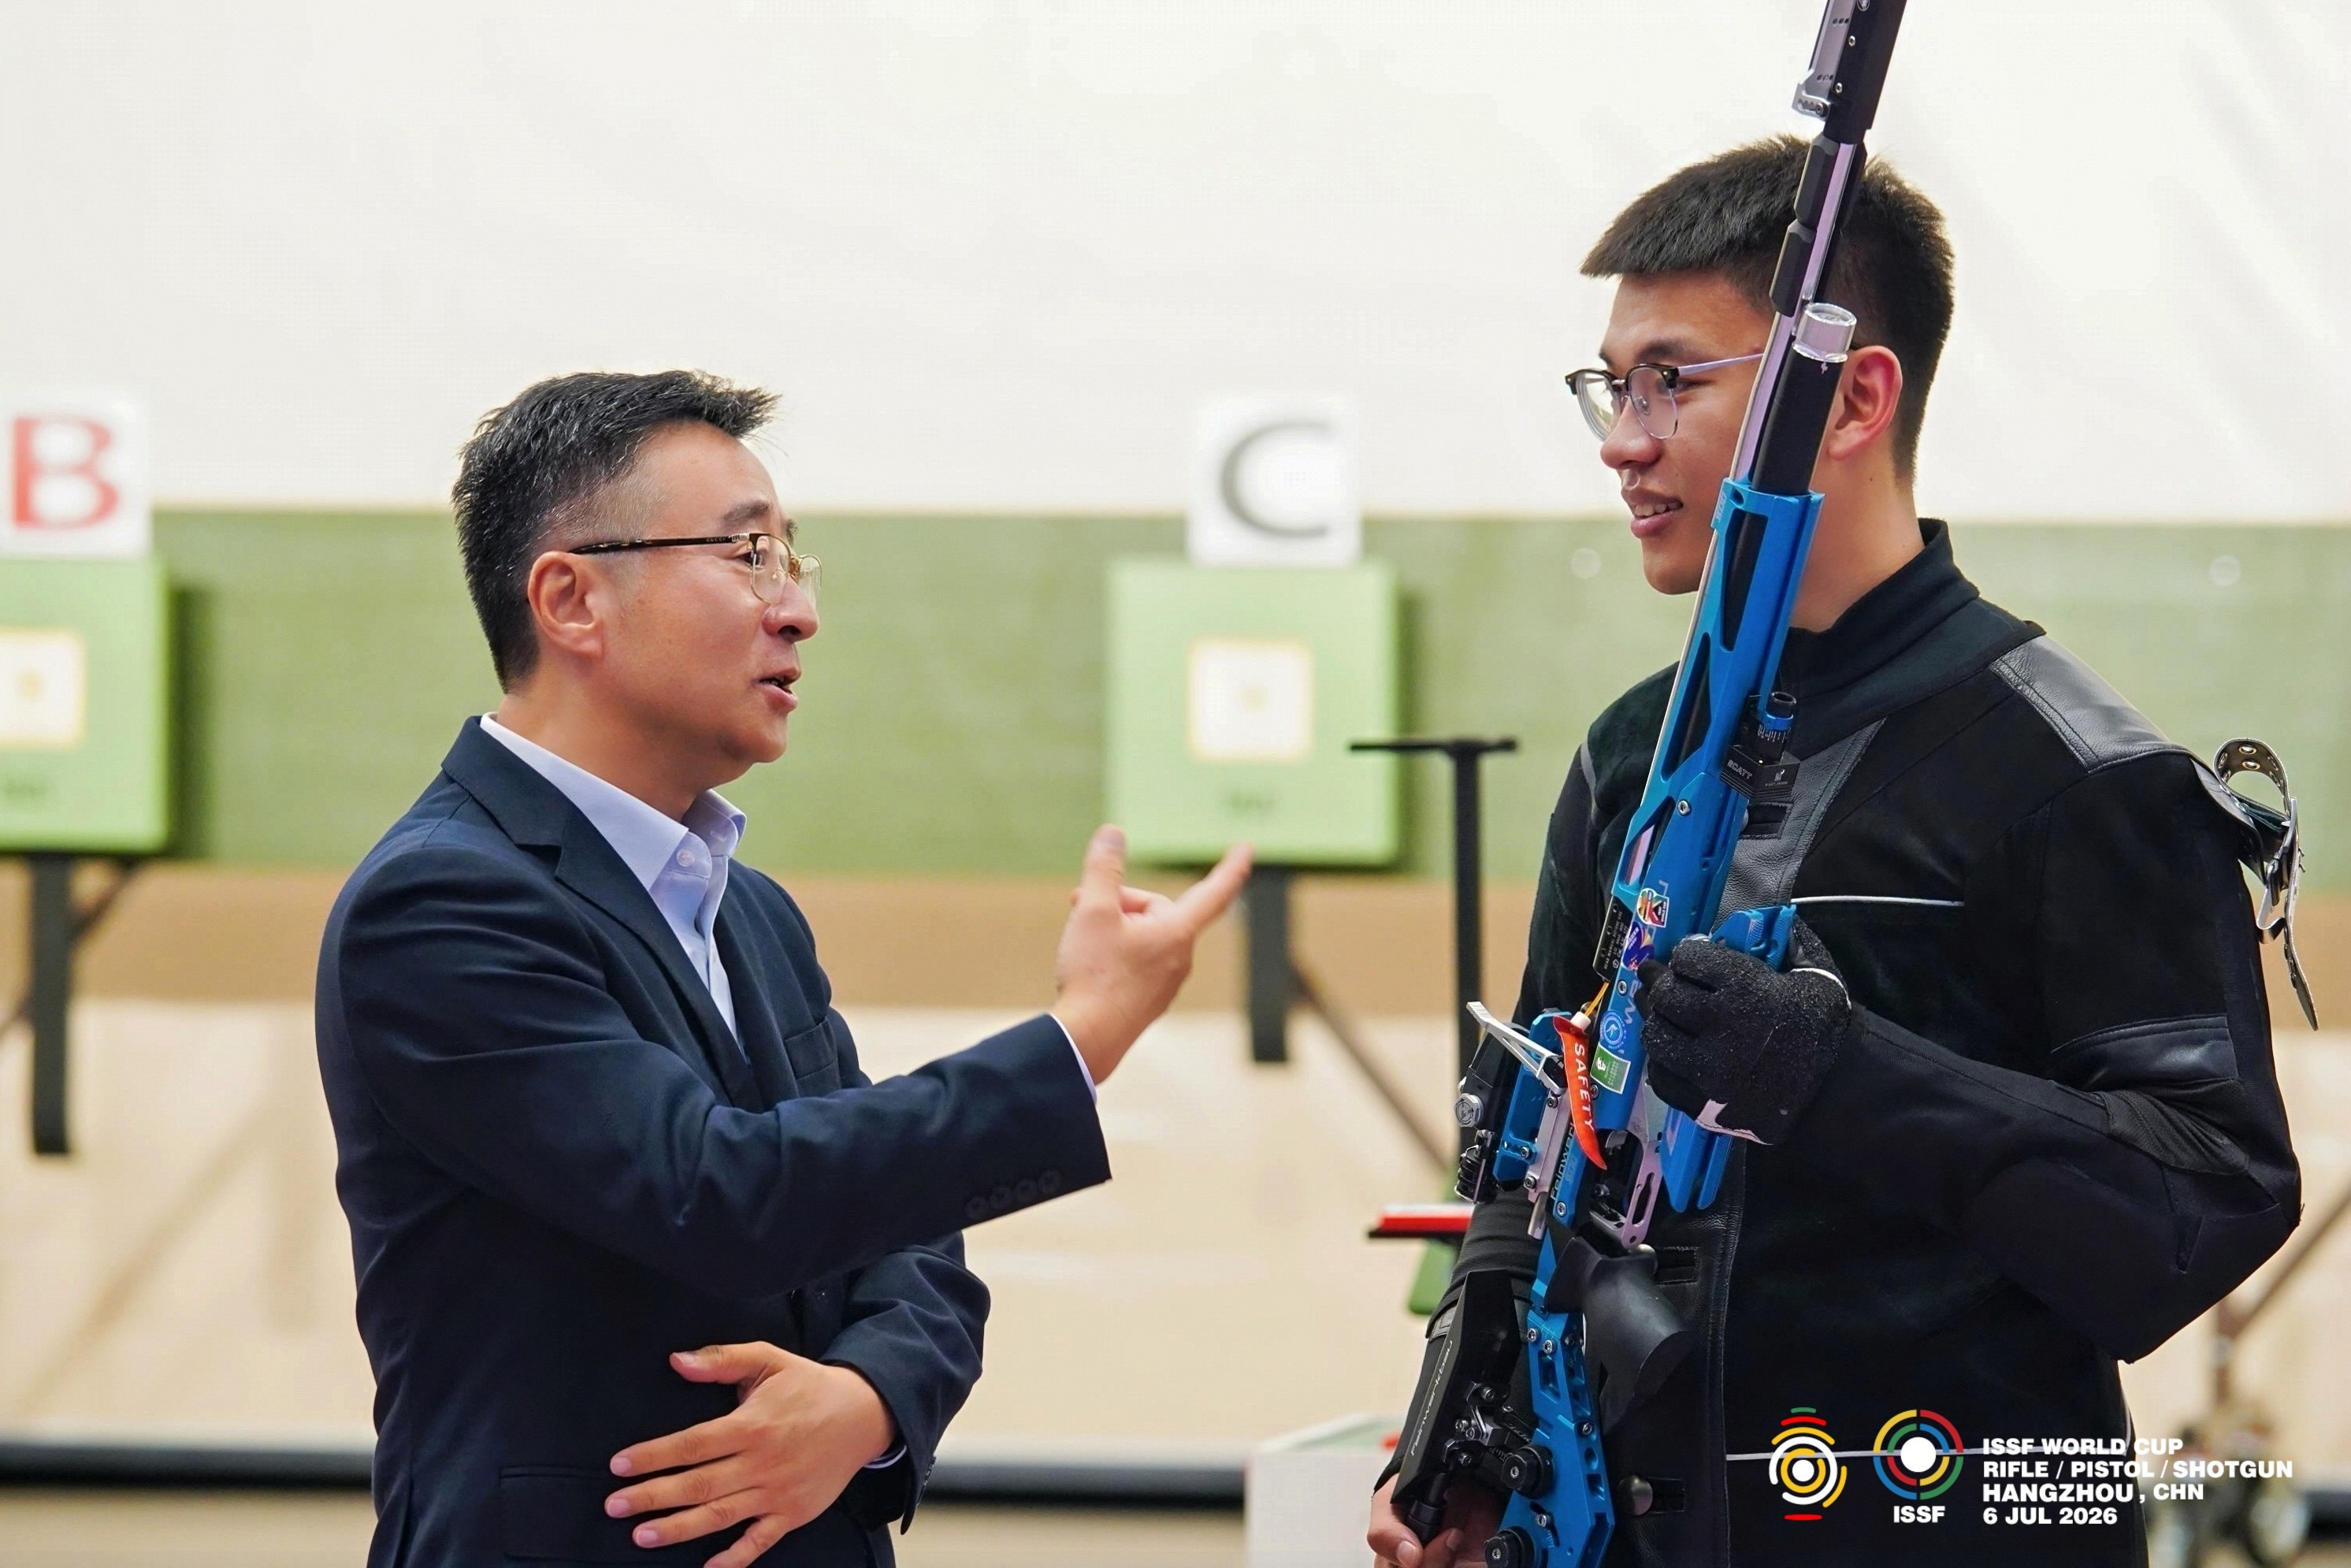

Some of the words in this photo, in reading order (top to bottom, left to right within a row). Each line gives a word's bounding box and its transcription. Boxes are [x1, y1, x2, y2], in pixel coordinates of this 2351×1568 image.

[10, 414, 122, 530] B
[1220, 419, 1335, 537] C
[1573, 1040, 1595, 1132] SAFETY
